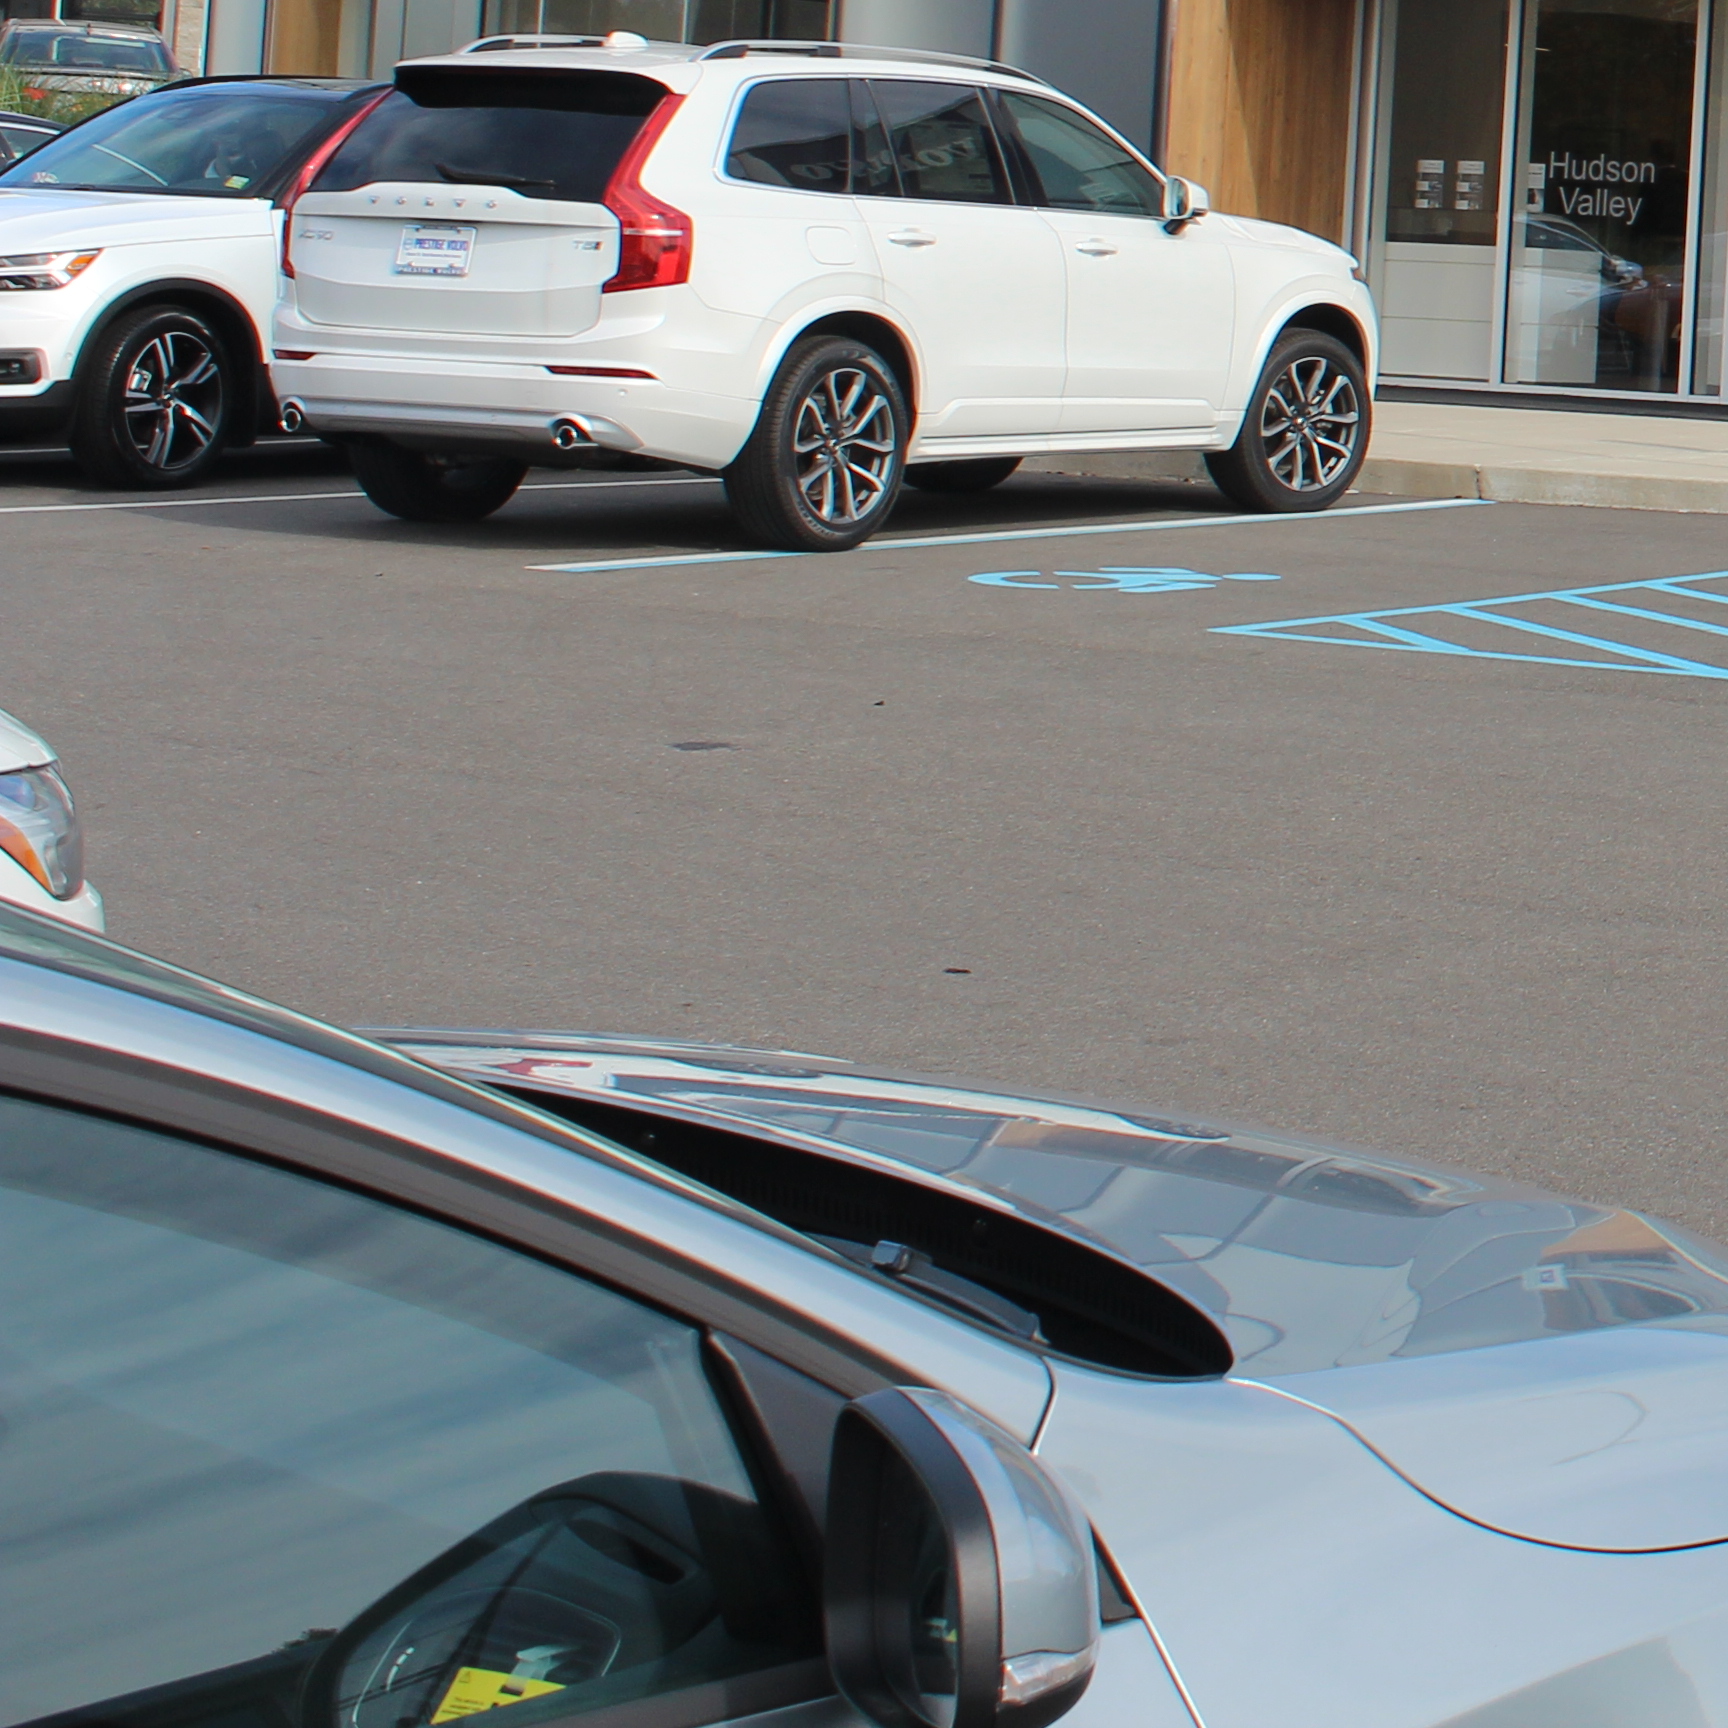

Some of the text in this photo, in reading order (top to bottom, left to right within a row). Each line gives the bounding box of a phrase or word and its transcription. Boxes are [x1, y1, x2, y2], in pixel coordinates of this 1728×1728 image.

[1548, 151, 1656, 184] Hudson
[369, 195, 498, 210] VOLVO
[1559, 186, 1643, 226] Valley
